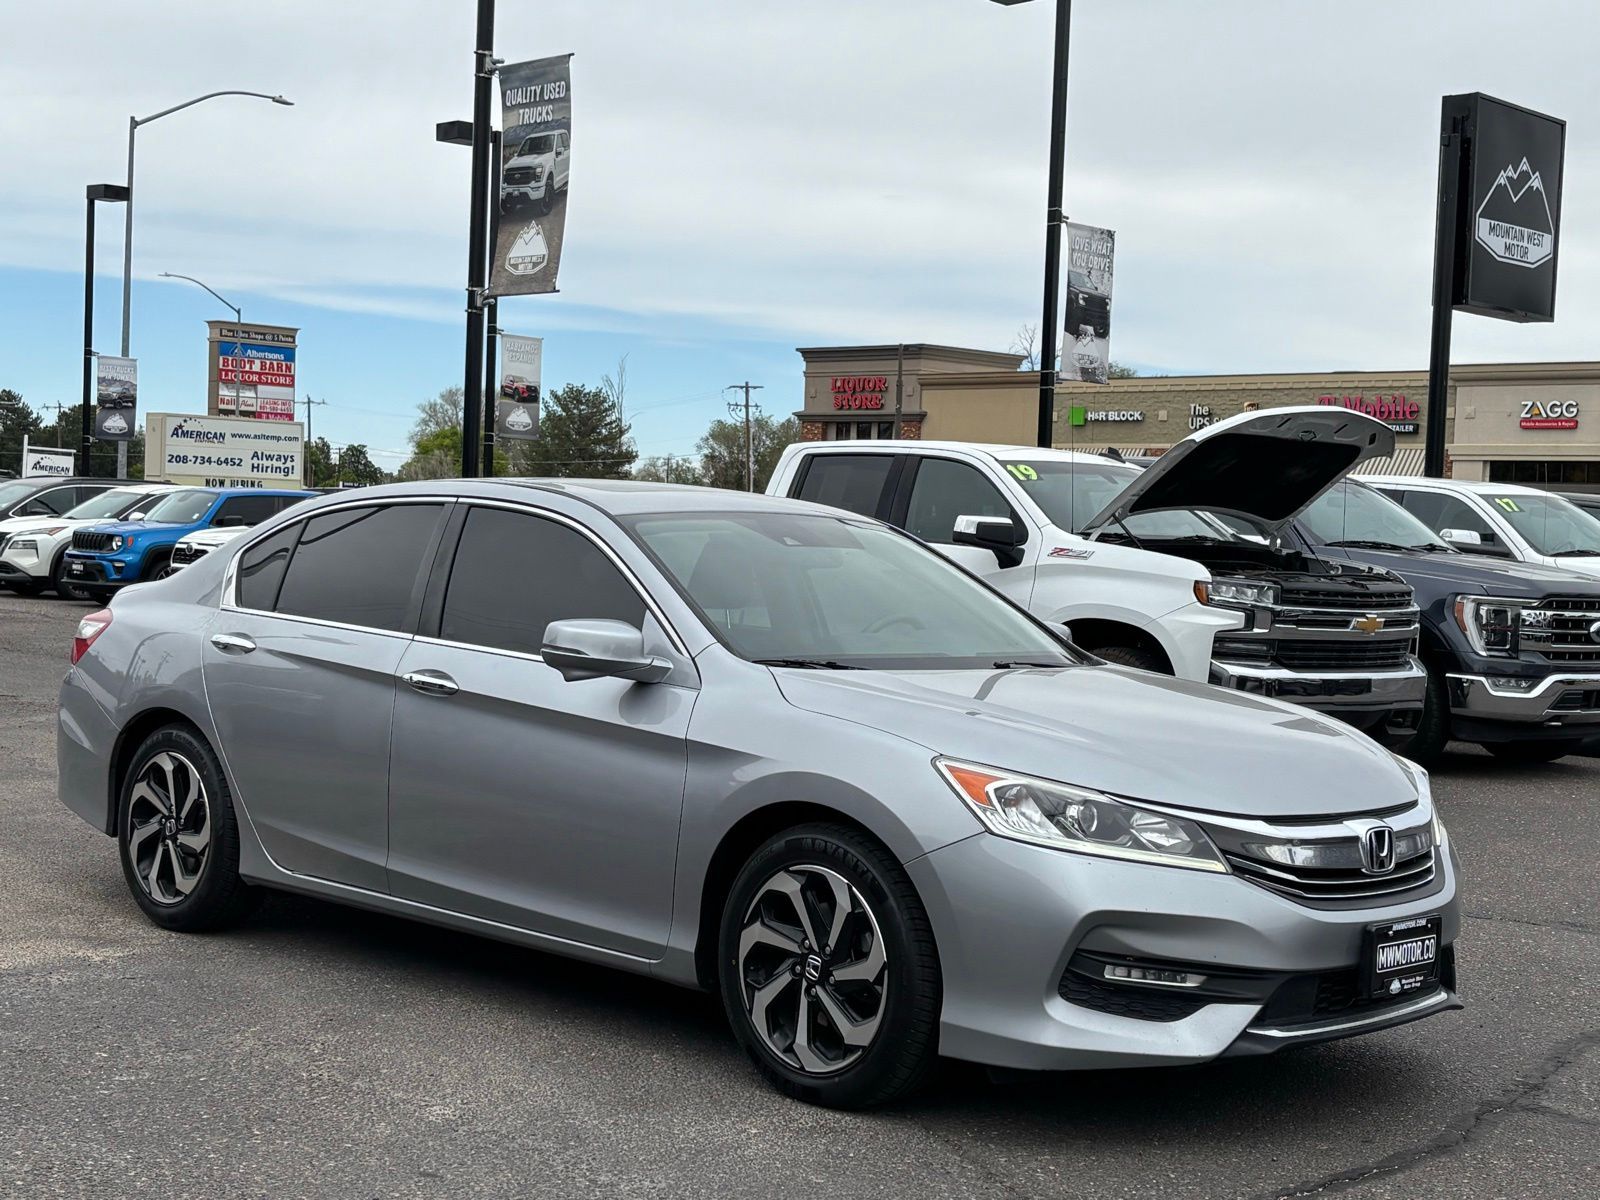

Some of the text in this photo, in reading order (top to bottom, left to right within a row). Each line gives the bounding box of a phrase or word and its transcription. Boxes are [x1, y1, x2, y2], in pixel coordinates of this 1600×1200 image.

[505, 81, 566, 107] QUALITY USED
[519, 104, 553, 125] TRUCKS
[1488, 221, 1545, 248] MOUNTAIN WEST
[1072, 237, 1112, 256] LOVE WHAT
[1504, 242, 1529, 260] MOTOR
[1072, 252, 1111, 272] YOU DRIVE
[234, 330, 249, 338] Lkes
[246, 349, 285, 360] Albertsons
[222, 356, 292, 374] BOOT BARN
[260, 374, 293, 385] STORE
[830, 376, 888, 393] LIQUOR
[832, 394, 885, 409] STORE
[1520, 400, 1578, 418] ZAGG
[1087, 411, 1143, 422] H&R BLOCK
[1189, 403, 1210, 416] The
[1188, 416, 1211, 430] UPS
[170, 426, 226, 441] AMERICAN
[167, 453, 244, 467] 208-734-6452
[250, 450, 295, 464] Always
[31, 462, 71, 474] AMERICAN
[251, 464, 295, 477] Hiring!
[1006, 463, 1039, 481] 19
[205, 478, 263, 489] NOW HIRING
[1494, 497, 1521, 513] 17
[1378, 938, 1435, 969] MWMOTOR.CO
